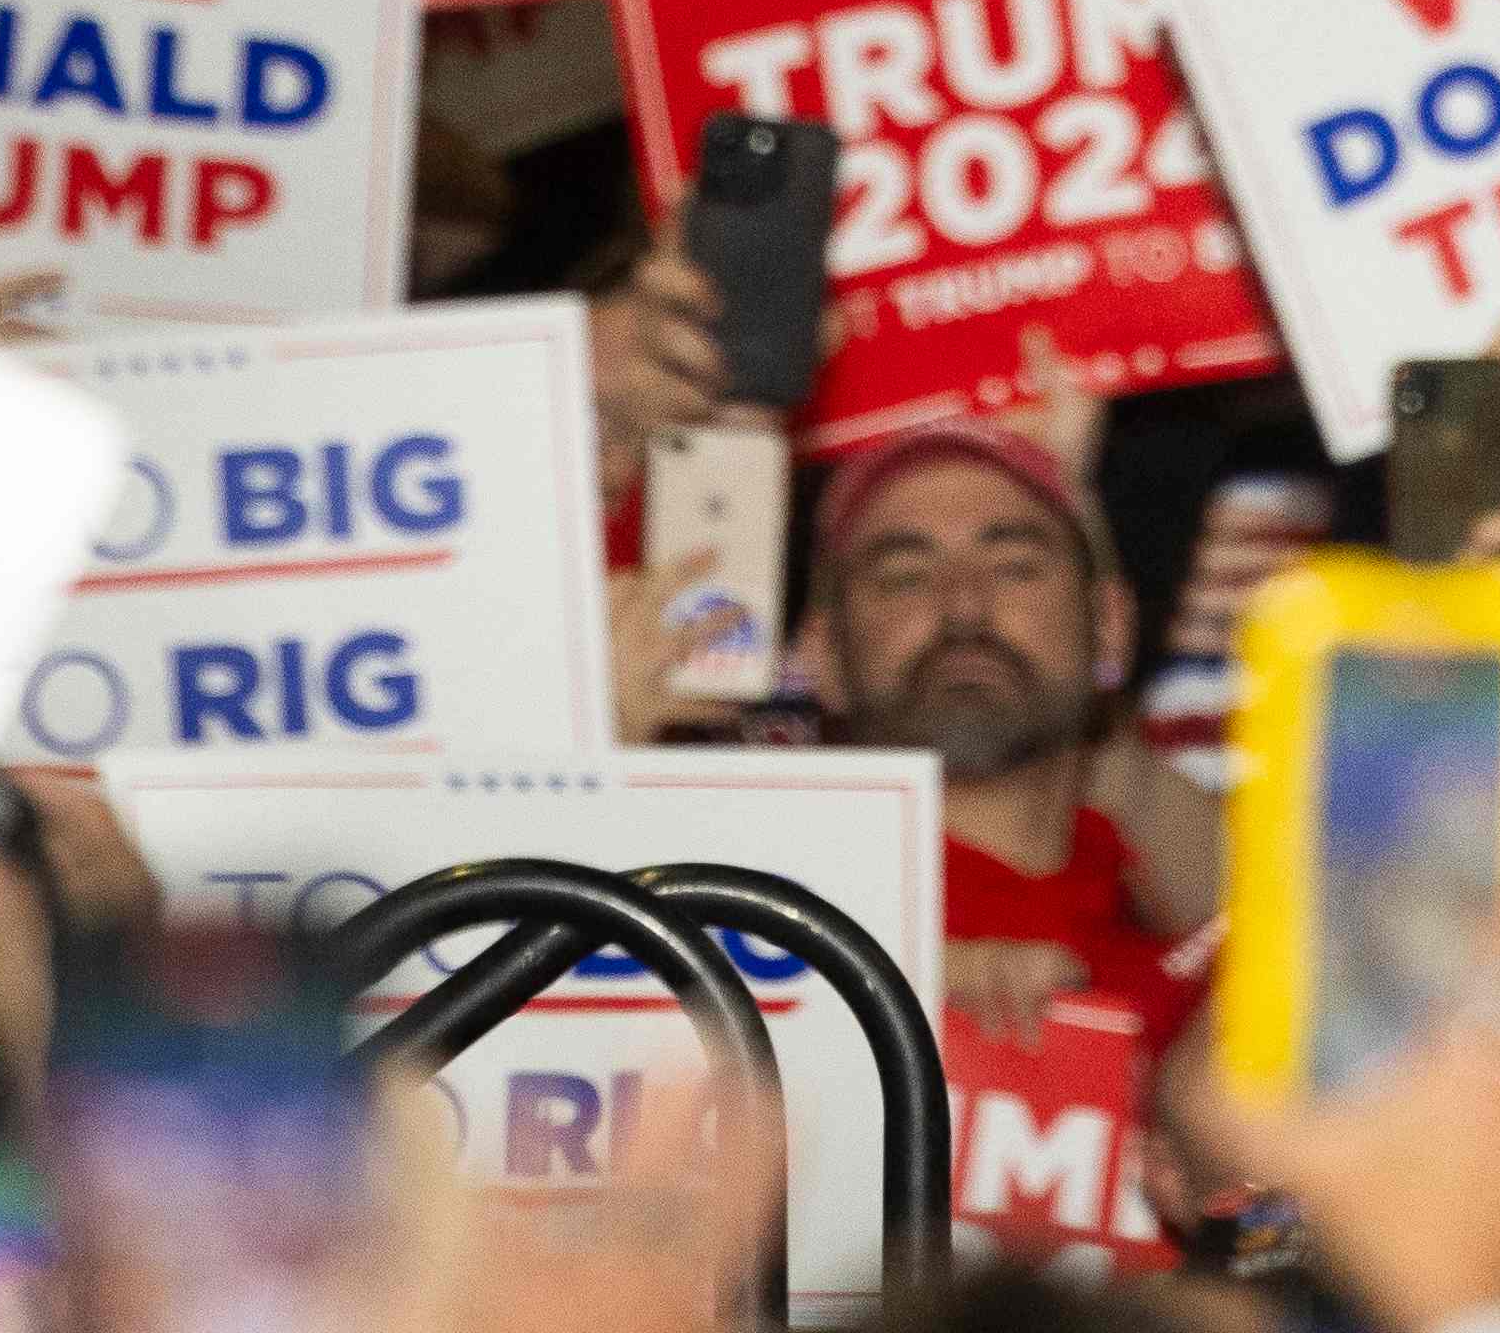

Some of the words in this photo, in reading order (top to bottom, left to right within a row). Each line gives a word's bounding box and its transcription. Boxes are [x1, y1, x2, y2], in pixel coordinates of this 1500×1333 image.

[216, 430, 470, 549] BIG
[20, 647, 132, 761] O
[170, 626, 425, 746] RIG
[503, 1068, 645, 1179] RI
